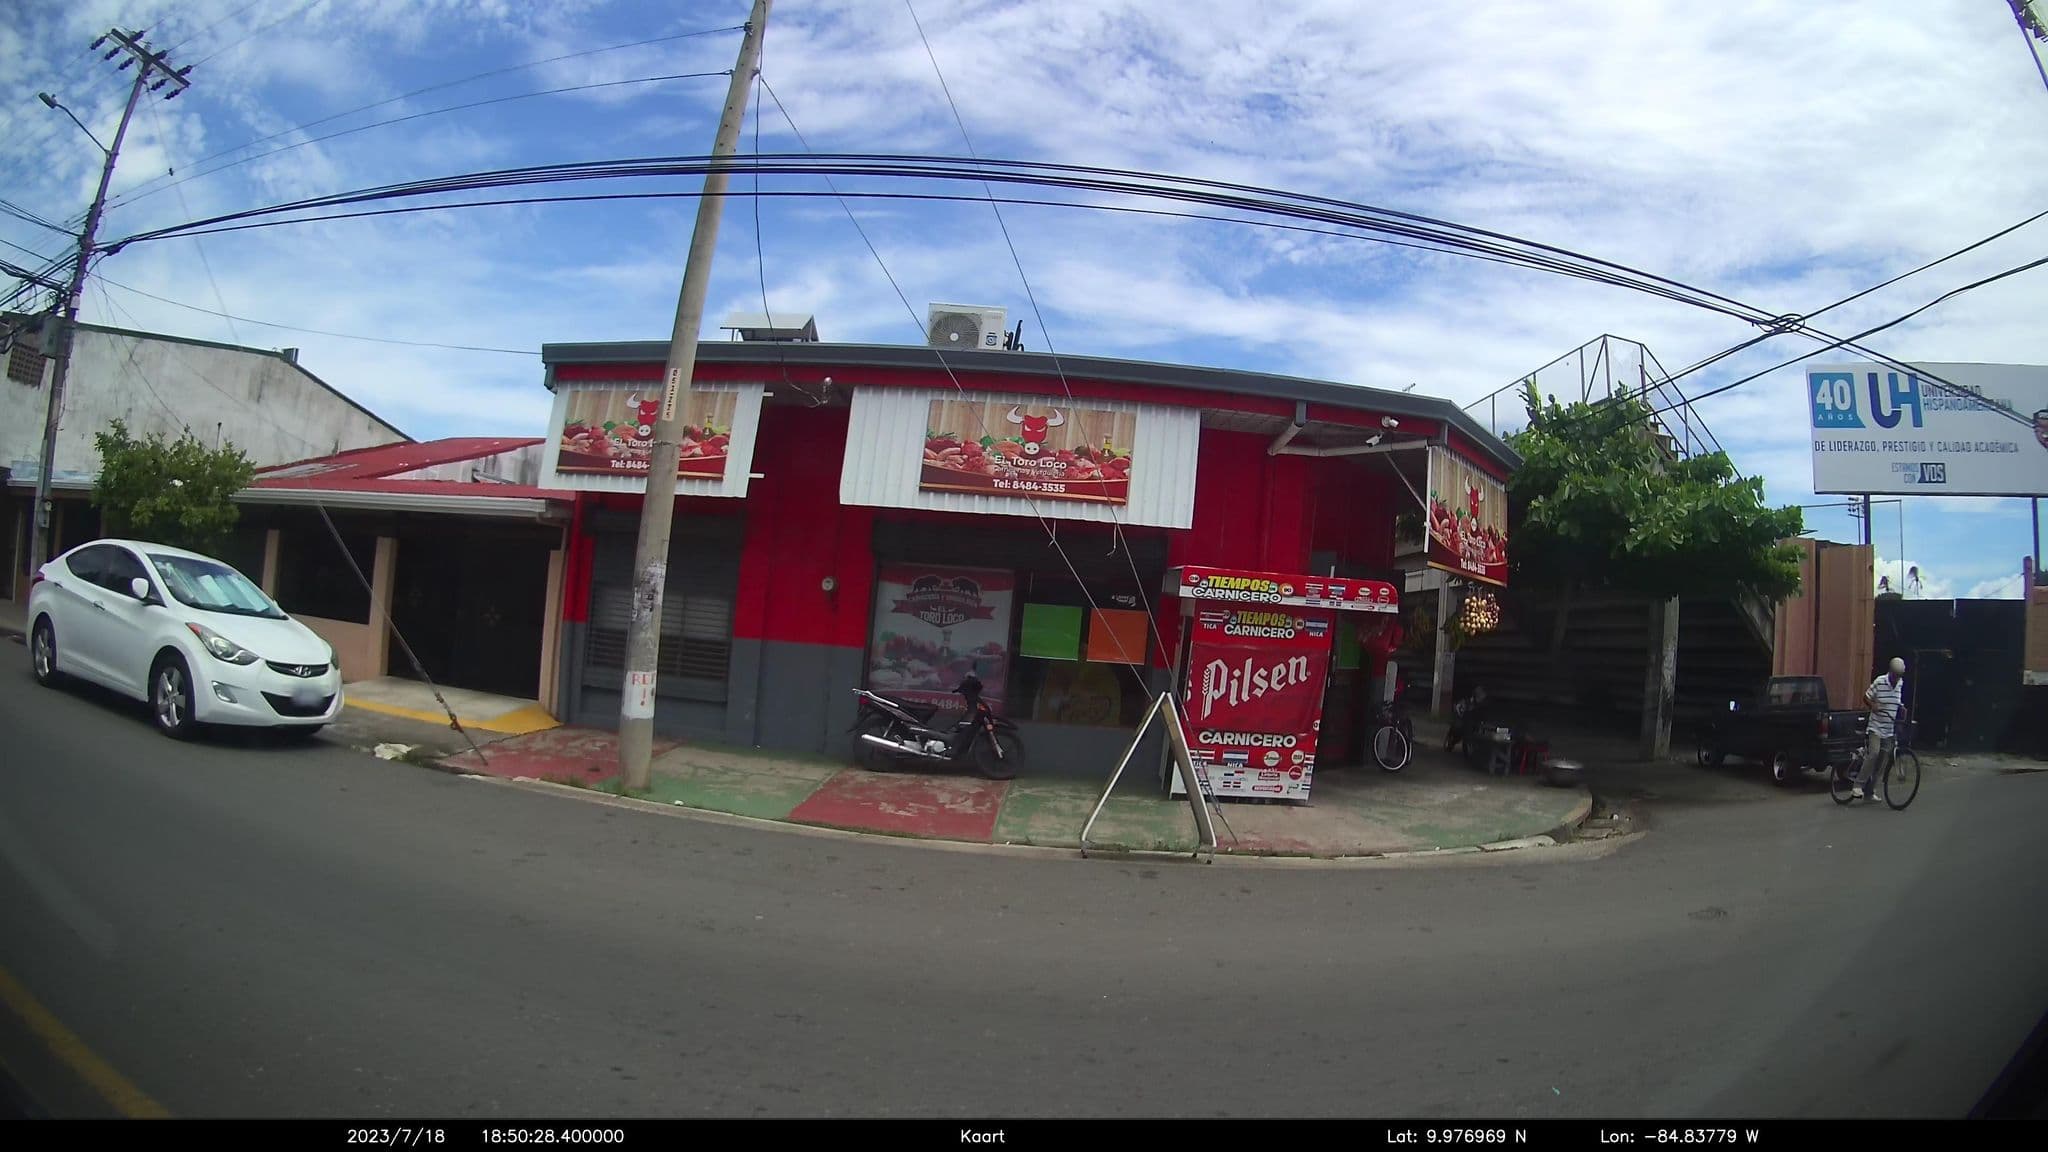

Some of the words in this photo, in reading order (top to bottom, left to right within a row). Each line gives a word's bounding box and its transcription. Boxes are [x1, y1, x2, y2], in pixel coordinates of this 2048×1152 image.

[1816, 379, 1851, 411] 40
[1868, 373, 1922, 428] UH
[1818, 412, 1854, 421] AÑOS
[1814, 441, 1826, 452] DE
[1829, 440, 1879, 453] LIDERAZGO,
[1883, 441, 1927, 452] PRESTIGIO
[1929, 441, 1934, 452] Y
[1937, 441, 1972, 453] CALIDAD
[625, 460, 651, 469] 8484-
[1011, 456, 1037, 467] Toro
[1040, 458, 1067, 469] Loco
[1922, 464, 1945, 482] VOS
[993, 479, 1011, 489] Tel:
[1012, 480, 1066, 493] 8484-3535
[1208, 575, 1270, 592] TIEMPOS
[1192, 587, 1282, 603] CARNICERO
[919, 610, 941, 624] TORO
[942, 612, 965, 624] LOCO
[1237, 610, 1287, 628] TIEMPOS
[1224, 624, 1295, 639] CARNICERO
[1201, 656, 1307, 720] Pilsen
[1199, 731, 1297, 748] CARNICERO
